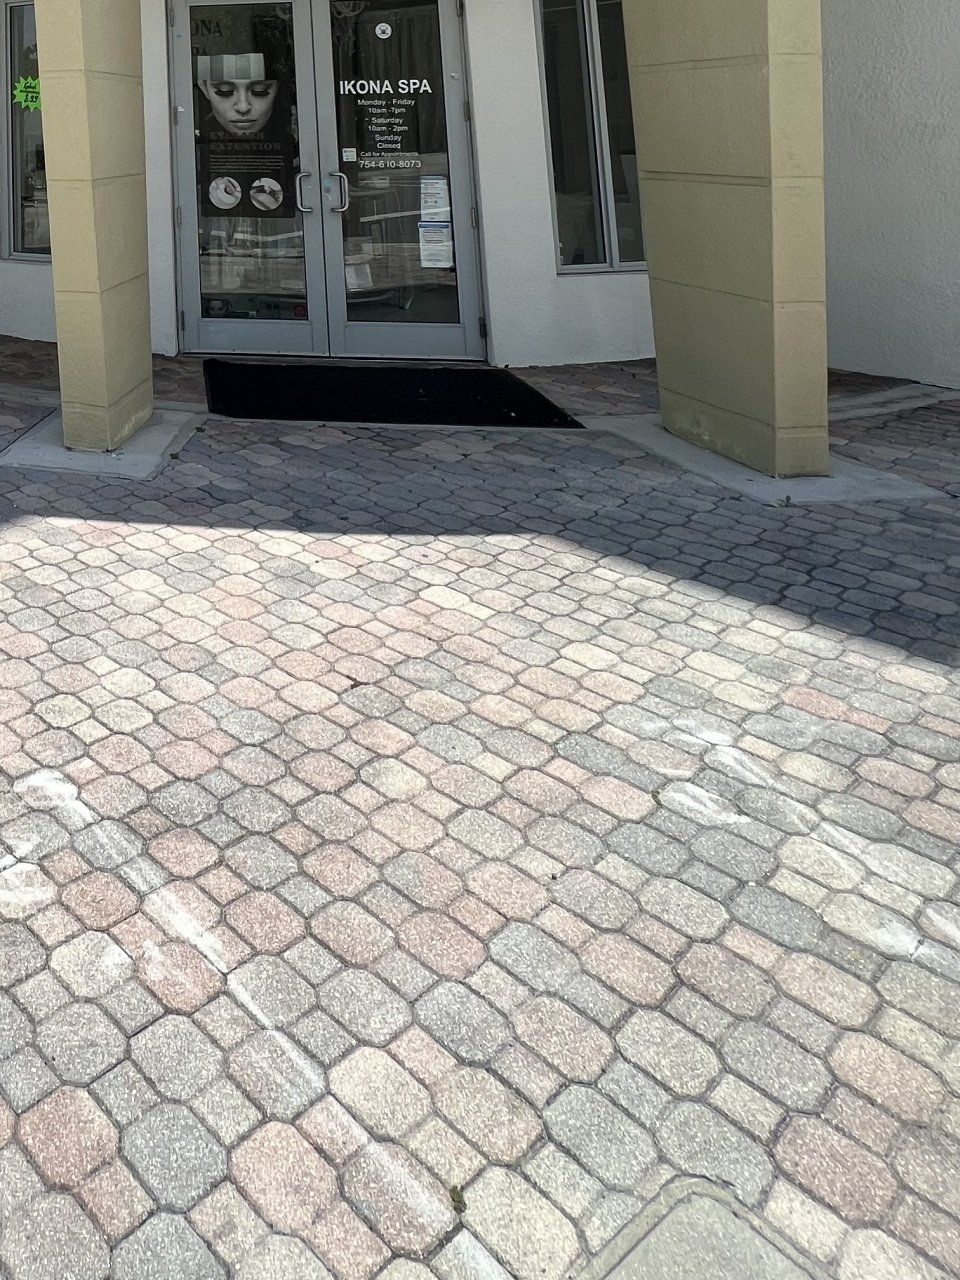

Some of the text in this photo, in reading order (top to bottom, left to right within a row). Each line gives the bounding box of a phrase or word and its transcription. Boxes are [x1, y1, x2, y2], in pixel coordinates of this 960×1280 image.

[340, 79, 432, 94] IKONA SPA
[392, 98, 416, 106] Friday
